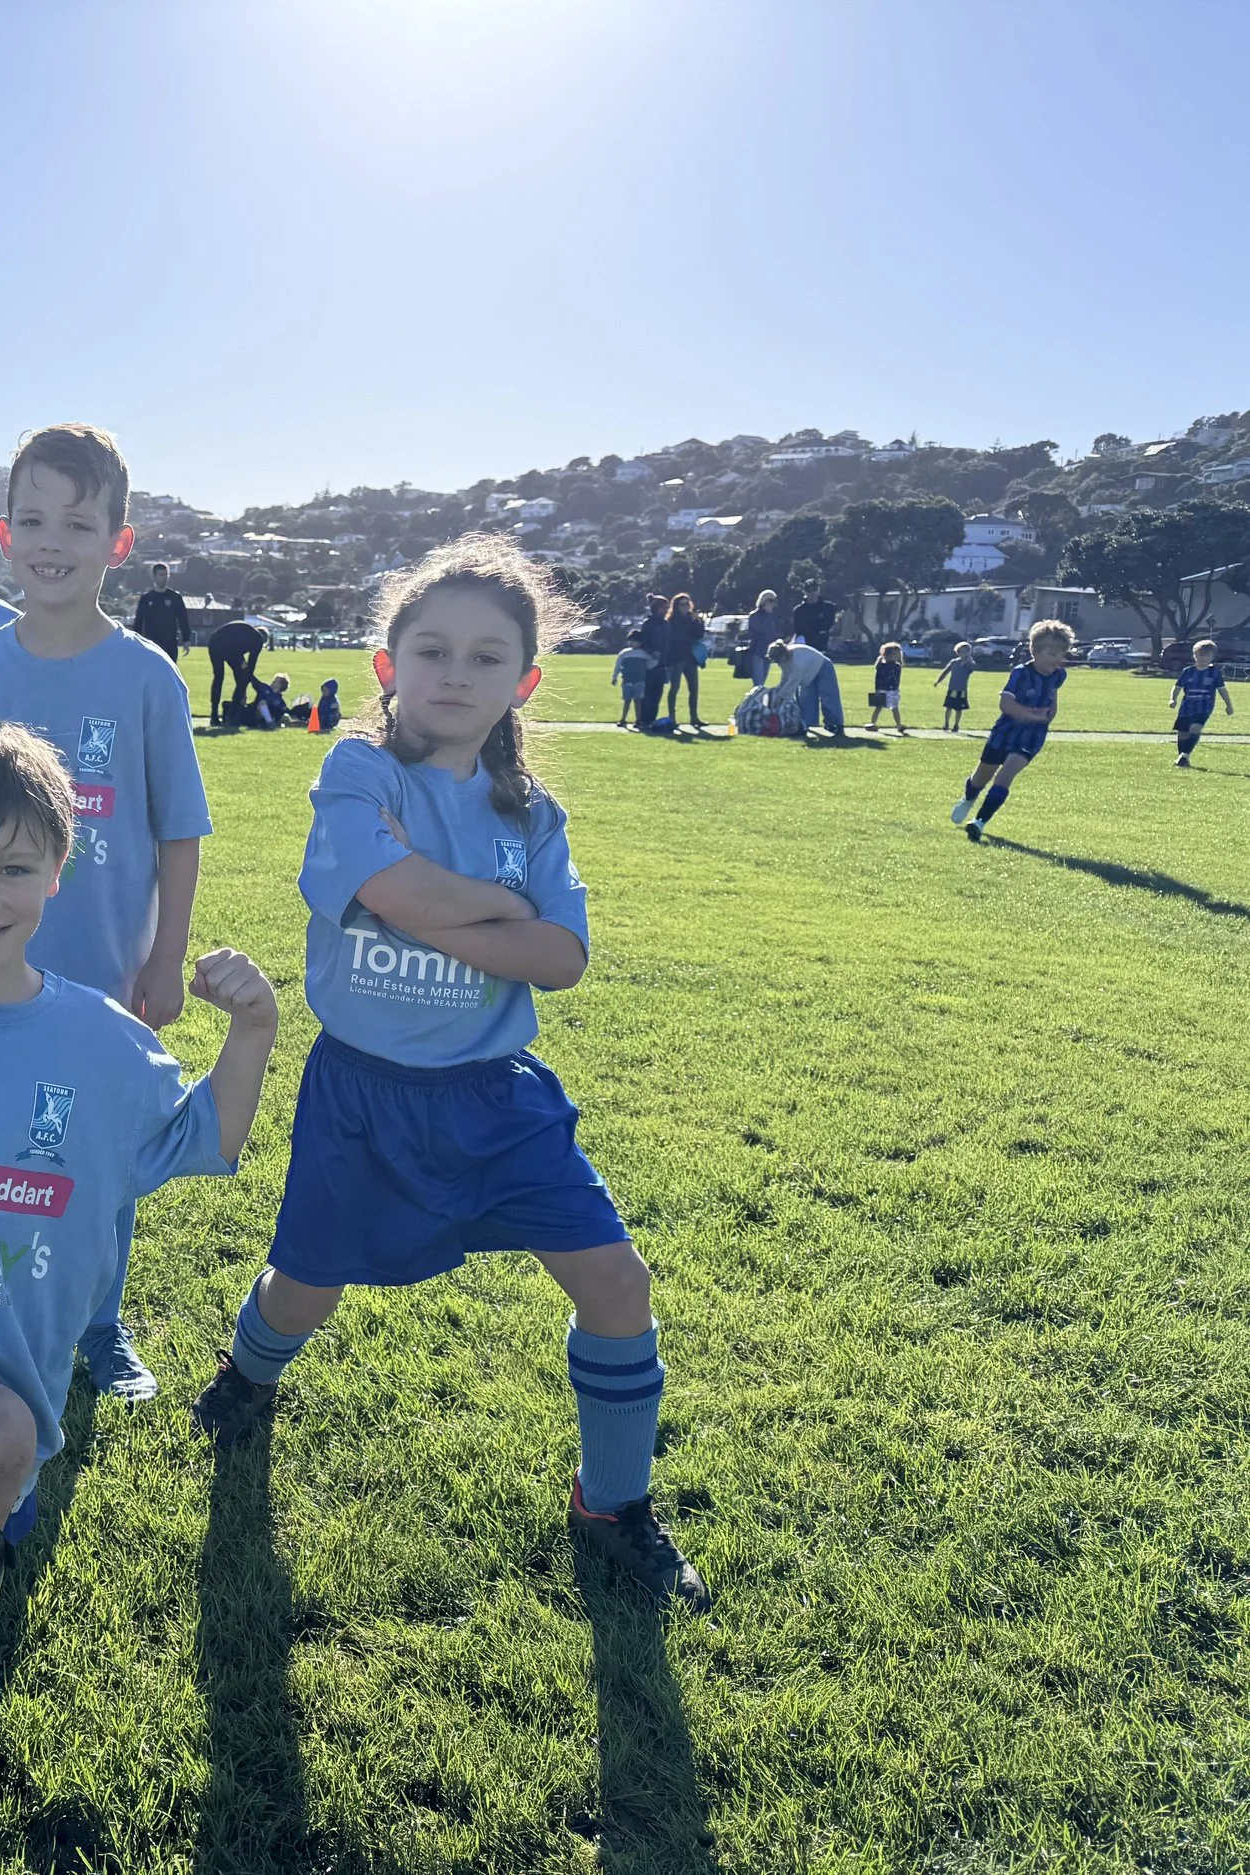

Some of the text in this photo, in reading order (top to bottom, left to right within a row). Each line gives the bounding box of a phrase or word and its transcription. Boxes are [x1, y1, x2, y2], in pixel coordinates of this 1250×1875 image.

[344, 928, 498, 1002] Tomm
[349, 985, 387, 998] Licensed
[389, 993, 415, 1003] under
[417, 997, 431, 1005] the
[433, 999, 458, 1008] REAA
[350, 974, 480, 999] Real Estate MREINZ
[43, 1085, 69, 1096] SEATOUN
[35, 1130, 56, 1143] A.F.C.
